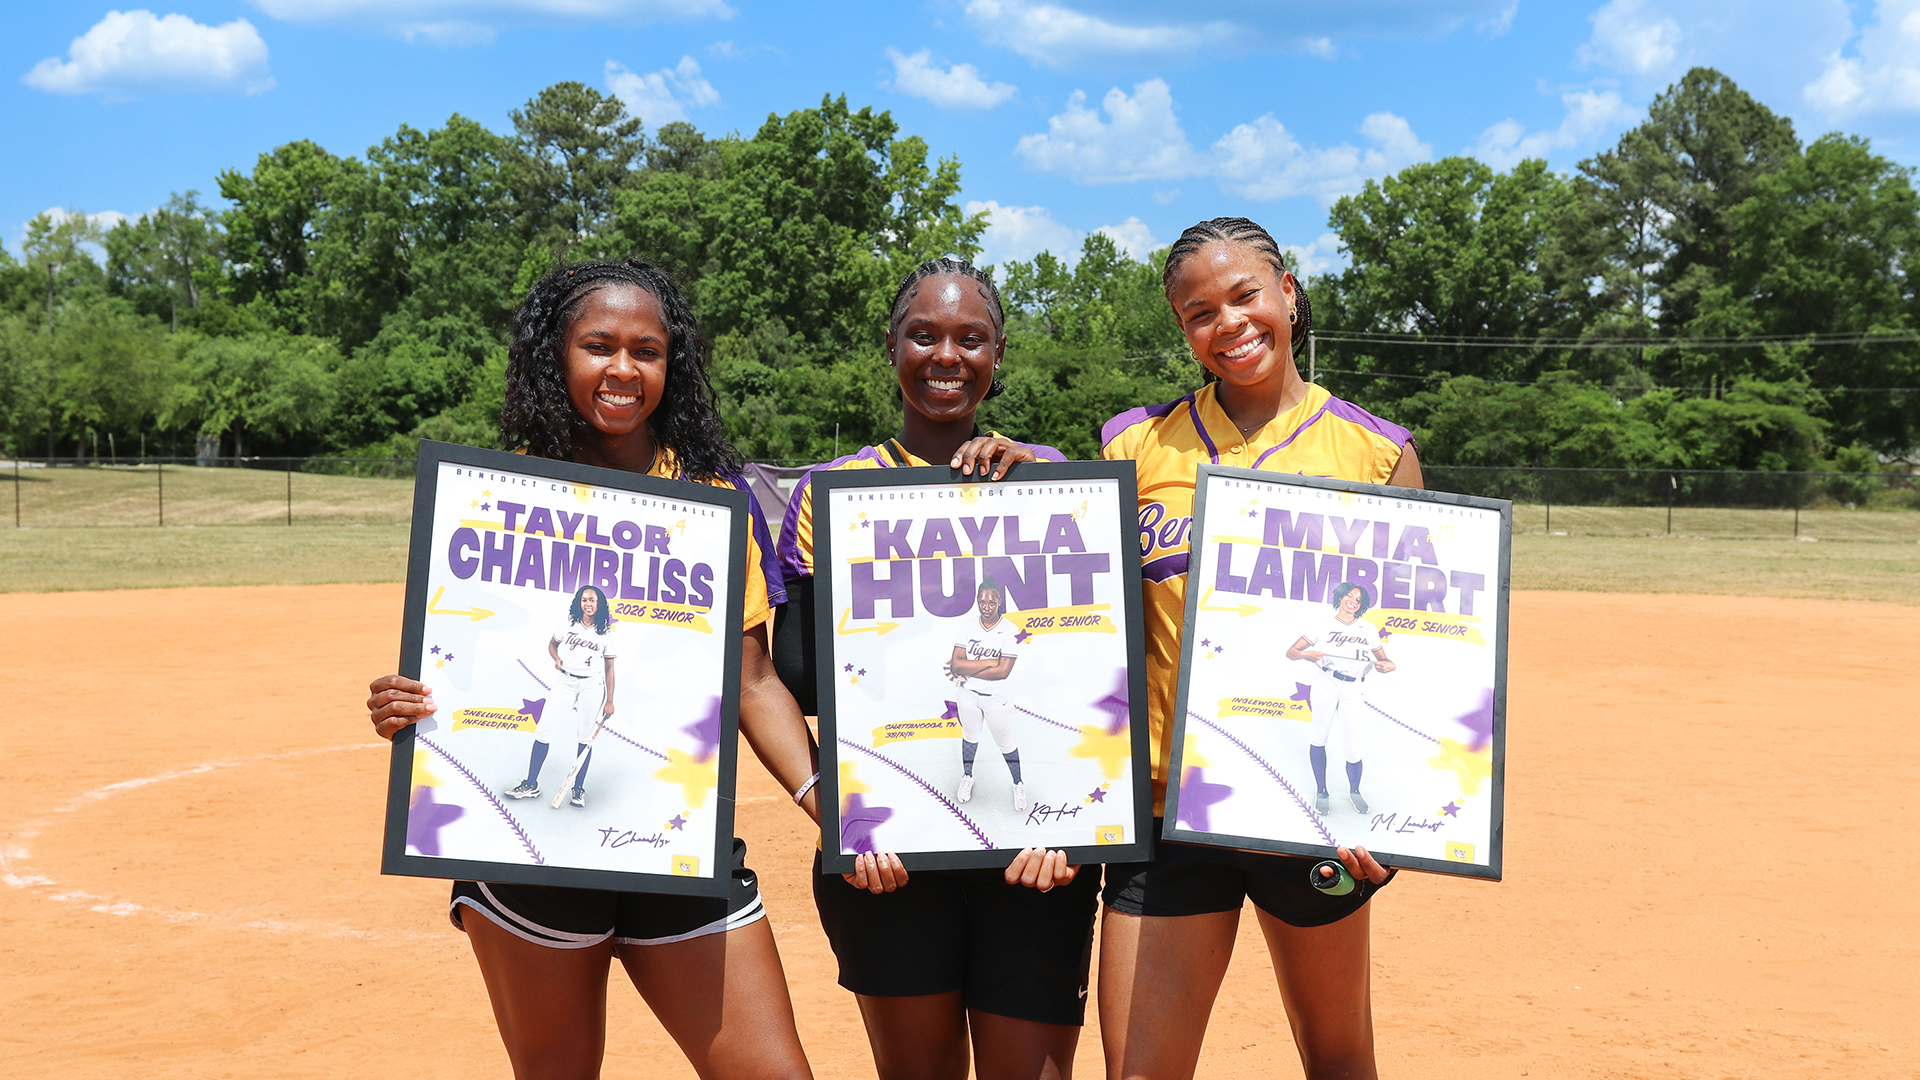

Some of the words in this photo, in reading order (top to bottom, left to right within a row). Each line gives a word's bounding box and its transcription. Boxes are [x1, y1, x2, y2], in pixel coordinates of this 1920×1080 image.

[456, 468, 537, 488] BENEDICT
[551, 484, 617, 502] COLLEGE
[631, 497, 715, 518] SOFTBALLL
[848, 492, 924, 501] BENEDICT
[938, 489, 1003, 498] COLLEGE
[1017, 486, 1103, 496] SOFTBALLL
[1225, 480, 1301, 496] BENEDICT
[1316, 492, 1382, 506] COLLEGE
[1070, 499, 1088, 522] #9
[497, 500, 671, 555] TAYLOR
[664, 518, 686, 539] #4
[873, 513, 1087, 560] KAYLA
[1263, 507, 1438, 566] MYIA
[448, 527, 714, 614] CHAMBLISS
[1215, 542, 1485, 616] LAMBERT
[850, 553, 1111, 620] HUNT
[615, 603, 647, 617] 2026
[650, 608, 695, 624] SENIOR
[1025, 616, 1054, 629] 2026
[1058, 615, 1102, 628] SENIOR
[1384, 616, 1416, 631] 2026
[1421, 621, 1469, 637] SENIOR
[565, 631, 600, 651] Tigers
[1326, 631, 1369, 647] Tigers
[967, 639, 1002, 661] Tigers
[1356, 649, 1370, 662] 15
[584, 656, 593, 667] 4
[1232, 697, 1286, 709] INGLEWOOD,
[1289, 704, 1303, 712] CA
